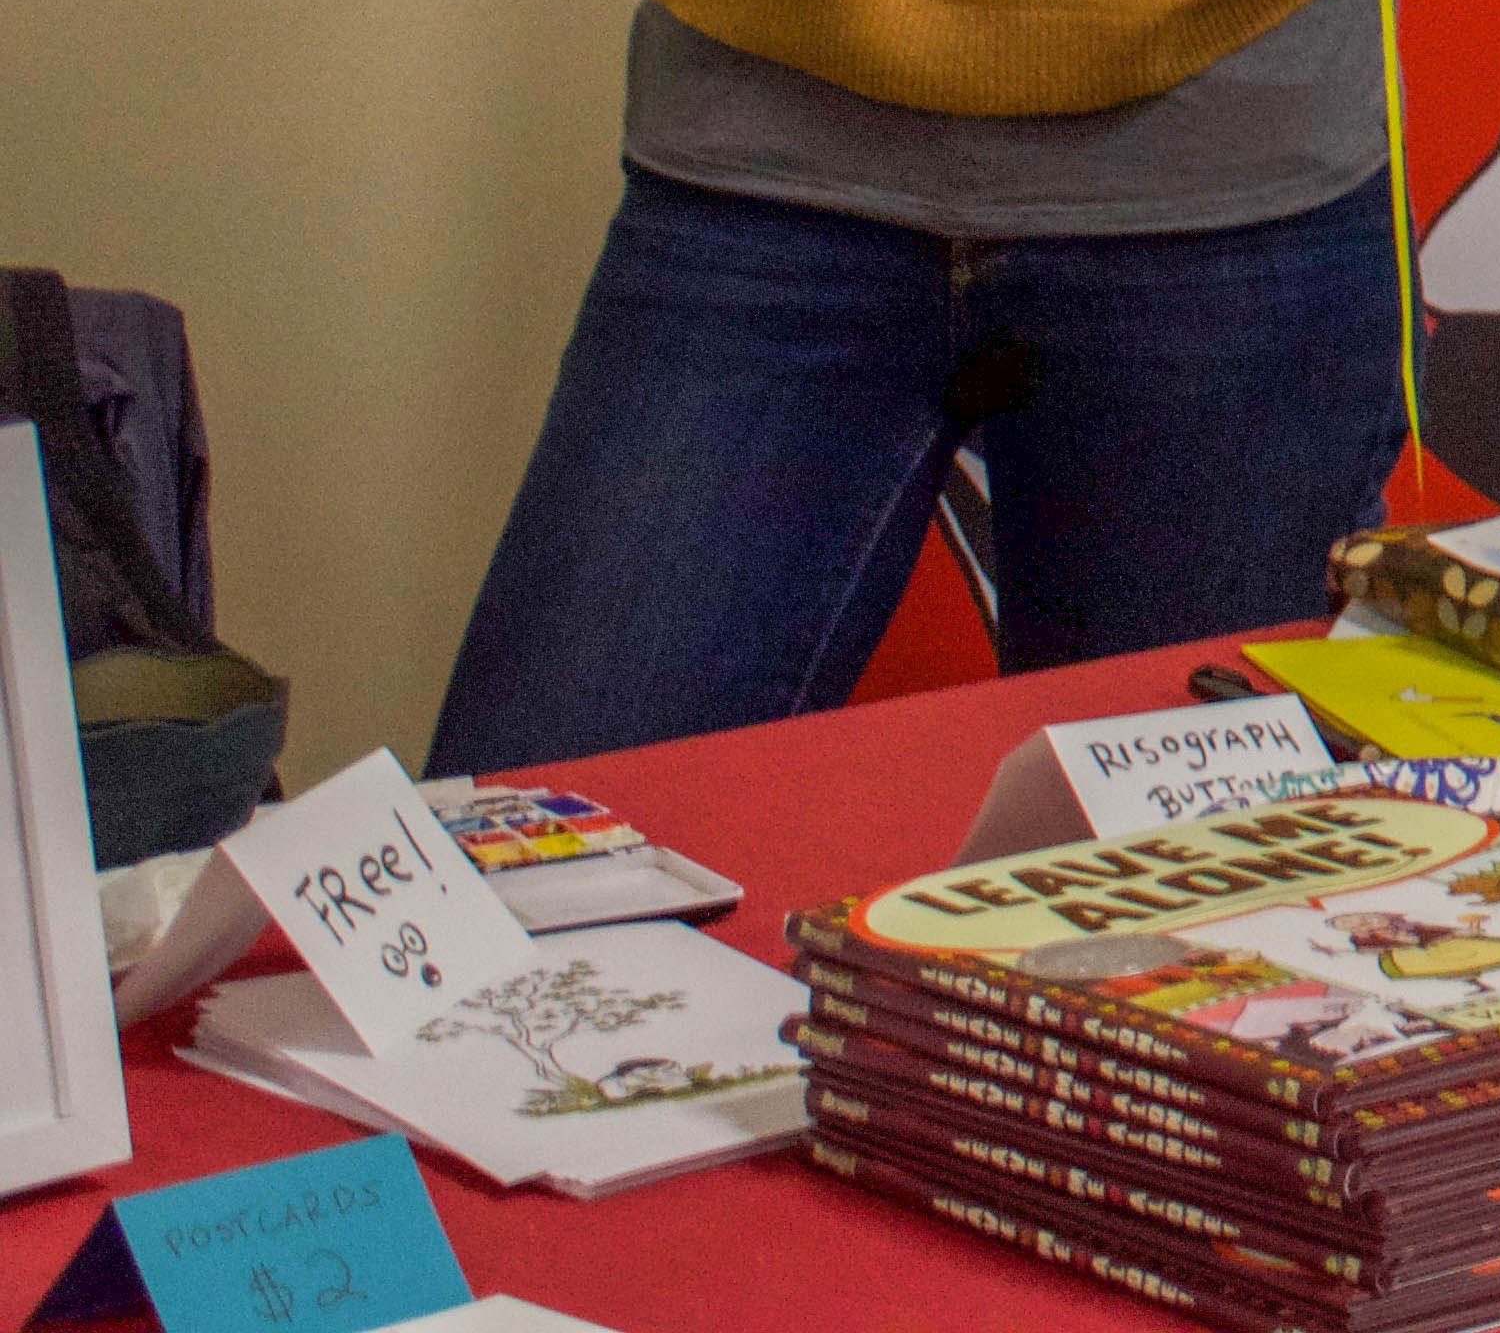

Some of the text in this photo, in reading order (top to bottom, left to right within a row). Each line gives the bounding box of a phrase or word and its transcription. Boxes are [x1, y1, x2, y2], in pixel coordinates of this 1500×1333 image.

[901, 802, 1387, 916] LEAVE ME
[1048, 831, 1432, 933] ALONE!
[163, 1179, 384, 1258] POSTCARDS
[249, 1246, 369, 1326] $2
